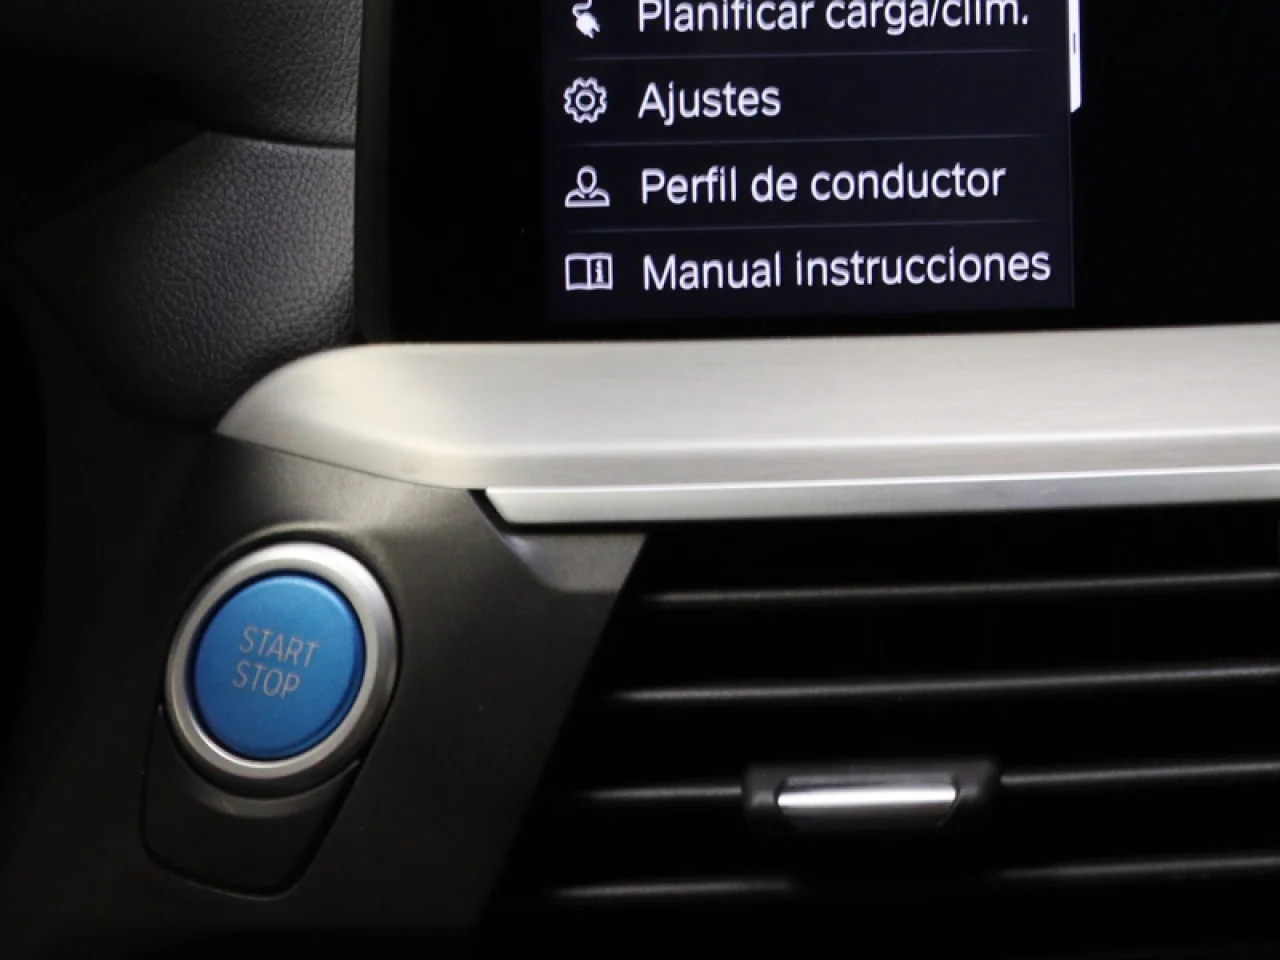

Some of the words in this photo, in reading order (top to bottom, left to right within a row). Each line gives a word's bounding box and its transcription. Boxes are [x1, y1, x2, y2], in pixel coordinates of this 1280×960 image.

[637, 80, 782, 127] Ajustes
[641, 164, 737, 205] Perfil
[750, 164, 799, 203] de
[810, 161, 1007, 201] conductor
[642, 250, 782, 291] Manual
[796, 245, 1052, 287] instrucciones
[239, 625, 320, 669] START
[233, 659, 302, 700] STOP
